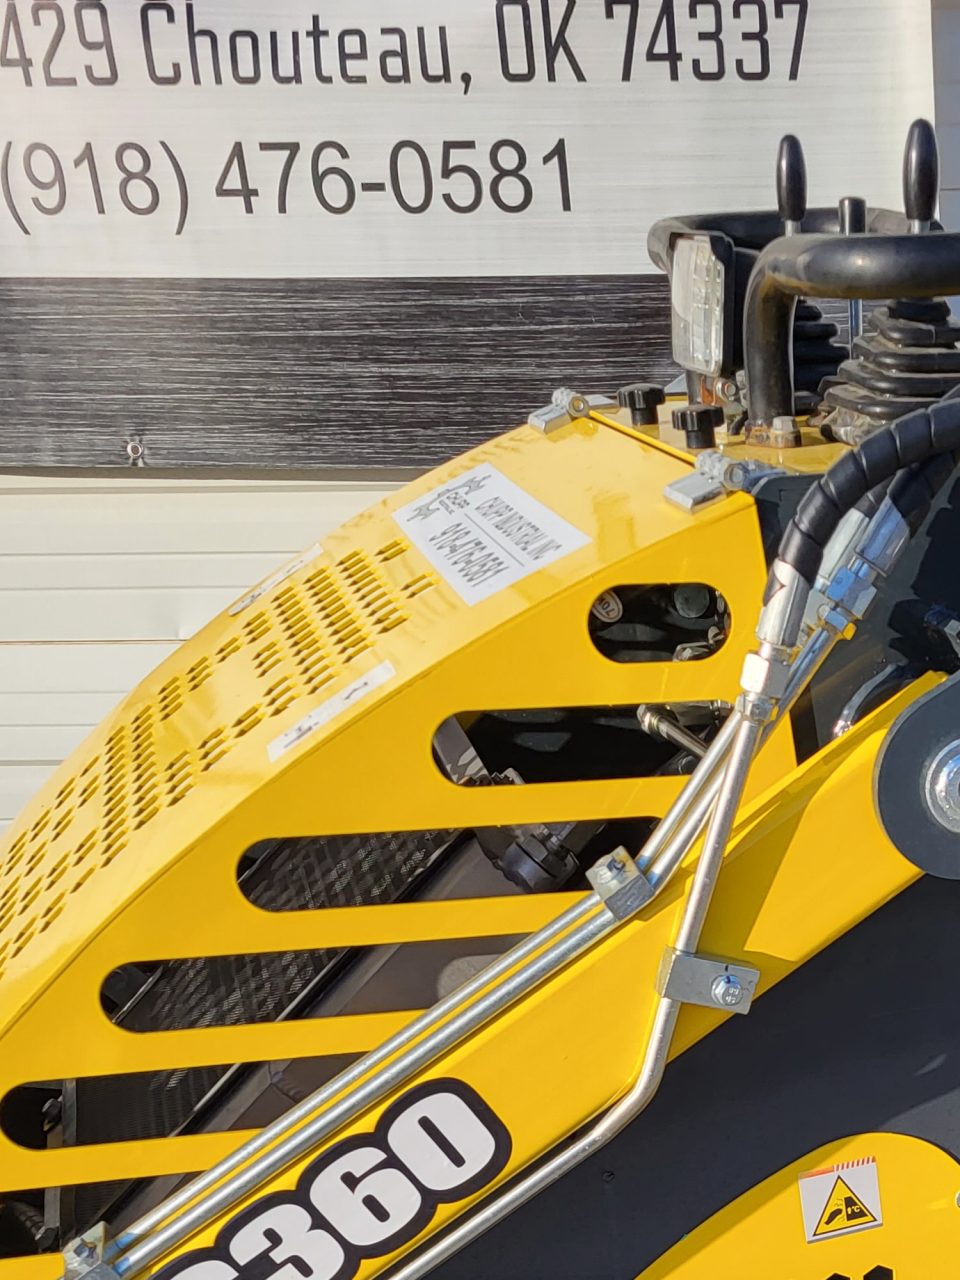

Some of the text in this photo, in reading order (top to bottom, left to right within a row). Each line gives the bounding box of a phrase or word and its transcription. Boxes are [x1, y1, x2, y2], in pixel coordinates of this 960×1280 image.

[0, 0, 810, 95] 429 Chouteau, OK 74337
[0, 138, 574, 236] (918) 476-0581
[427, 520, 510, 588] 918-476-0581
